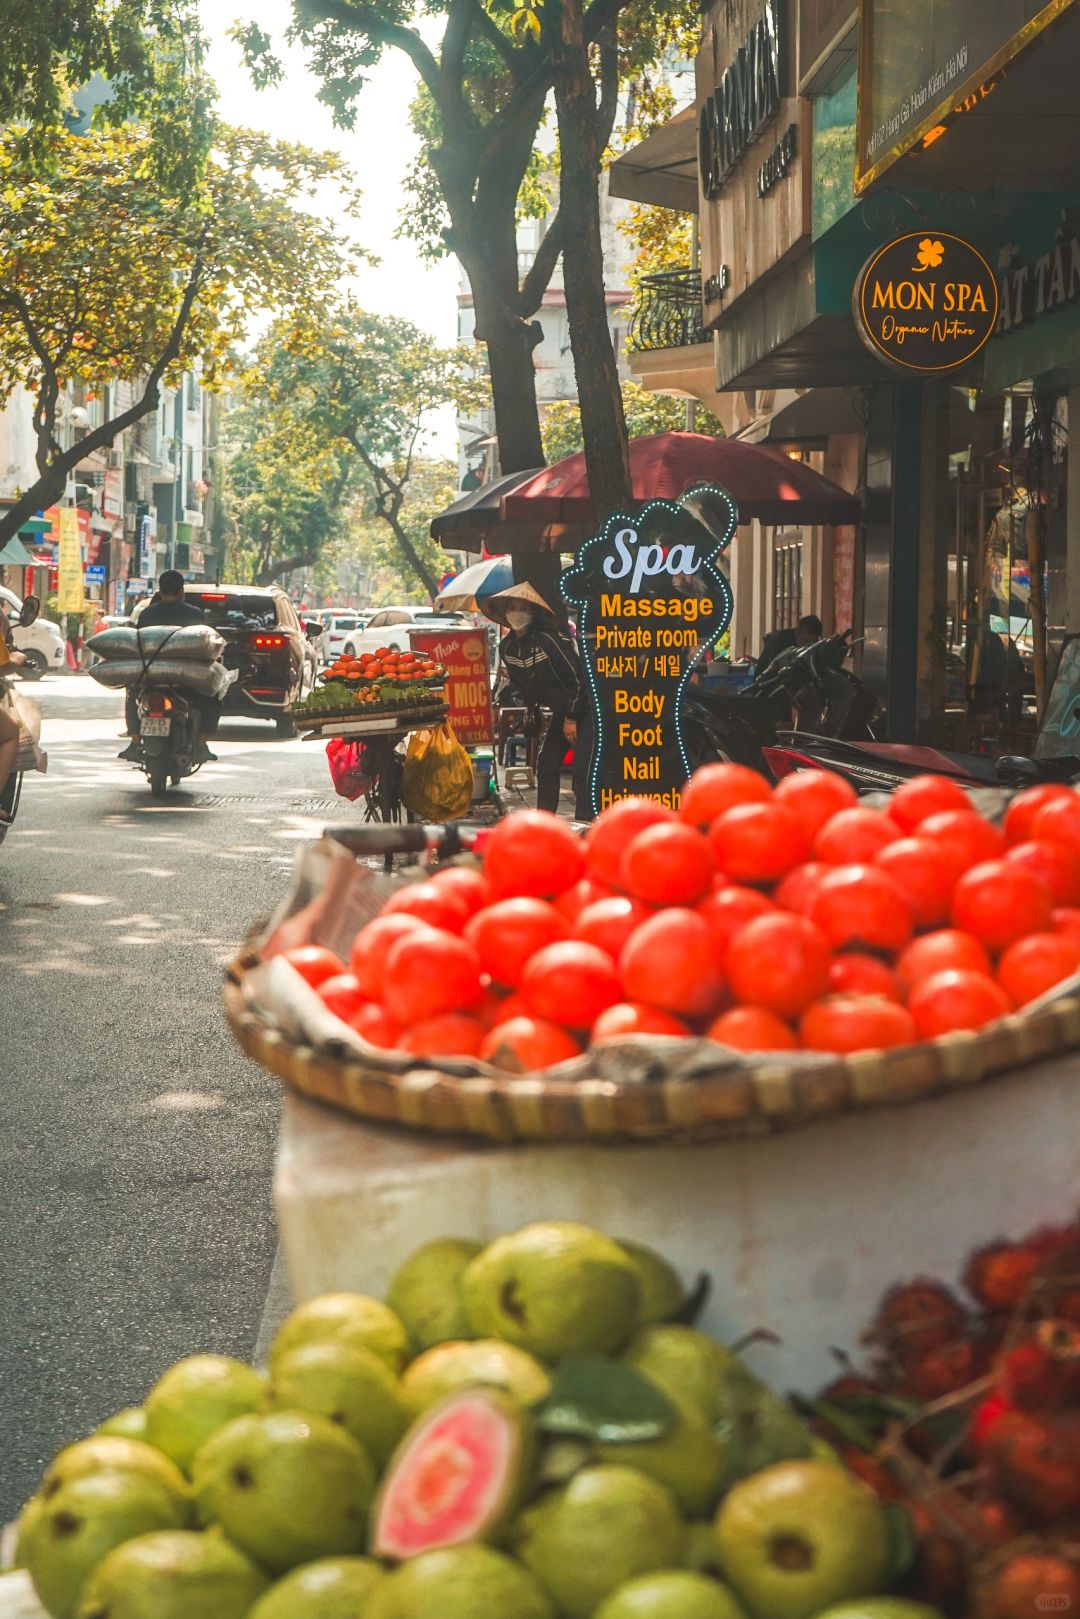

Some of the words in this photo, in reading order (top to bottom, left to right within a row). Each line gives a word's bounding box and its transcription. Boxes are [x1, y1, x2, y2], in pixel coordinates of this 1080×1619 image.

[871, 279, 936, 311] MON
[943, 283, 989, 312] SPA
[881, 314, 930, 345] Organic
[931, 317, 976, 343] Nature
[602, 528, 703, 593] Spa
[601, 593, 714, 622] Massage
[433, 640, 460, 661] Thoa
[596, 625, 652, 649] Private
[656, 628, 698, 648] room
[597, 655, 637, 678] 마사지
[642, 657, 650, 678] /
[654, 654, 681, 677] 네일
[454, 681, 488, 713] MỌC
[615, 690, 665, 718] Body
[619, 724, 663, 746] Foot
[623, 757, 660, 780] Nail
